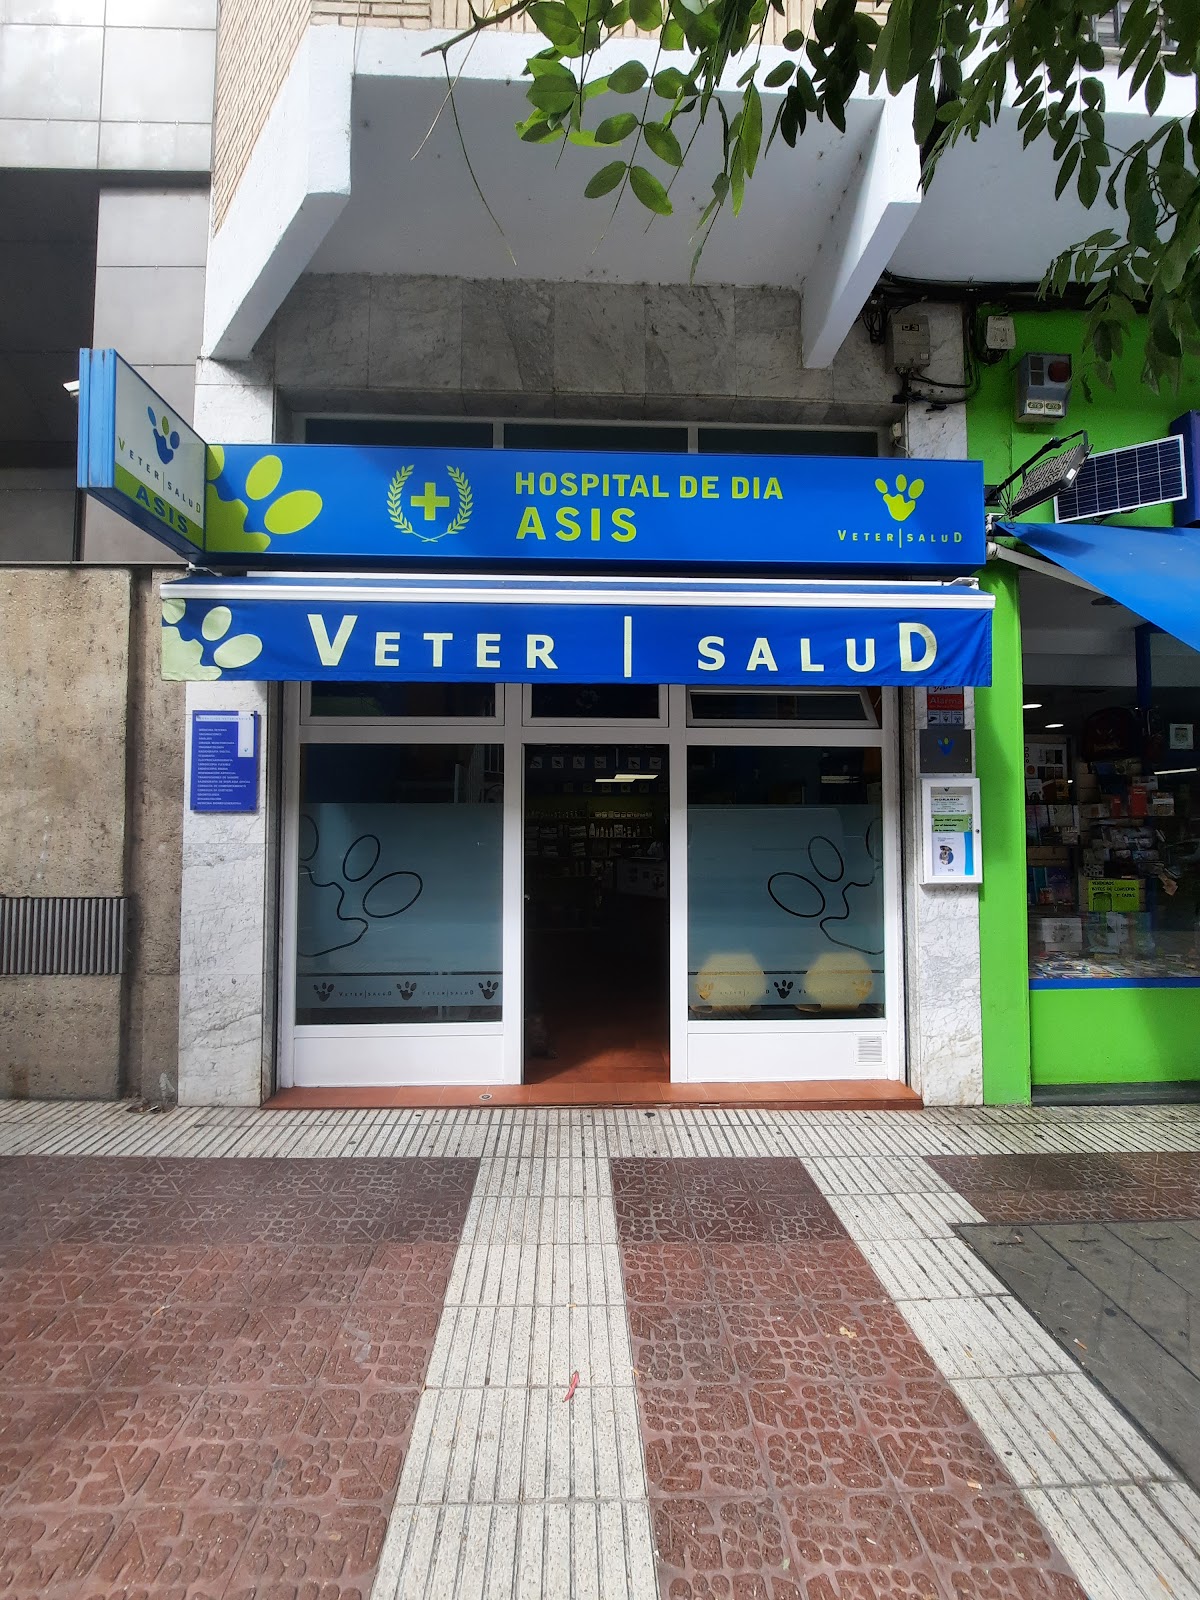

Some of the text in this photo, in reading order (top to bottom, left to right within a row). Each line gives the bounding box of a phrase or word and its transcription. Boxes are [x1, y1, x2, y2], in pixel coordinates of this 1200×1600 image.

[515, 471, 783, 500] HOSPITAL DE DIA
[136, 485, 188, 533] ASIS
[516, 507, 637, 542] ASIS
[307, 614, 938, 672] VETER SALUD
[930, 697, 962, 705] Alarma
